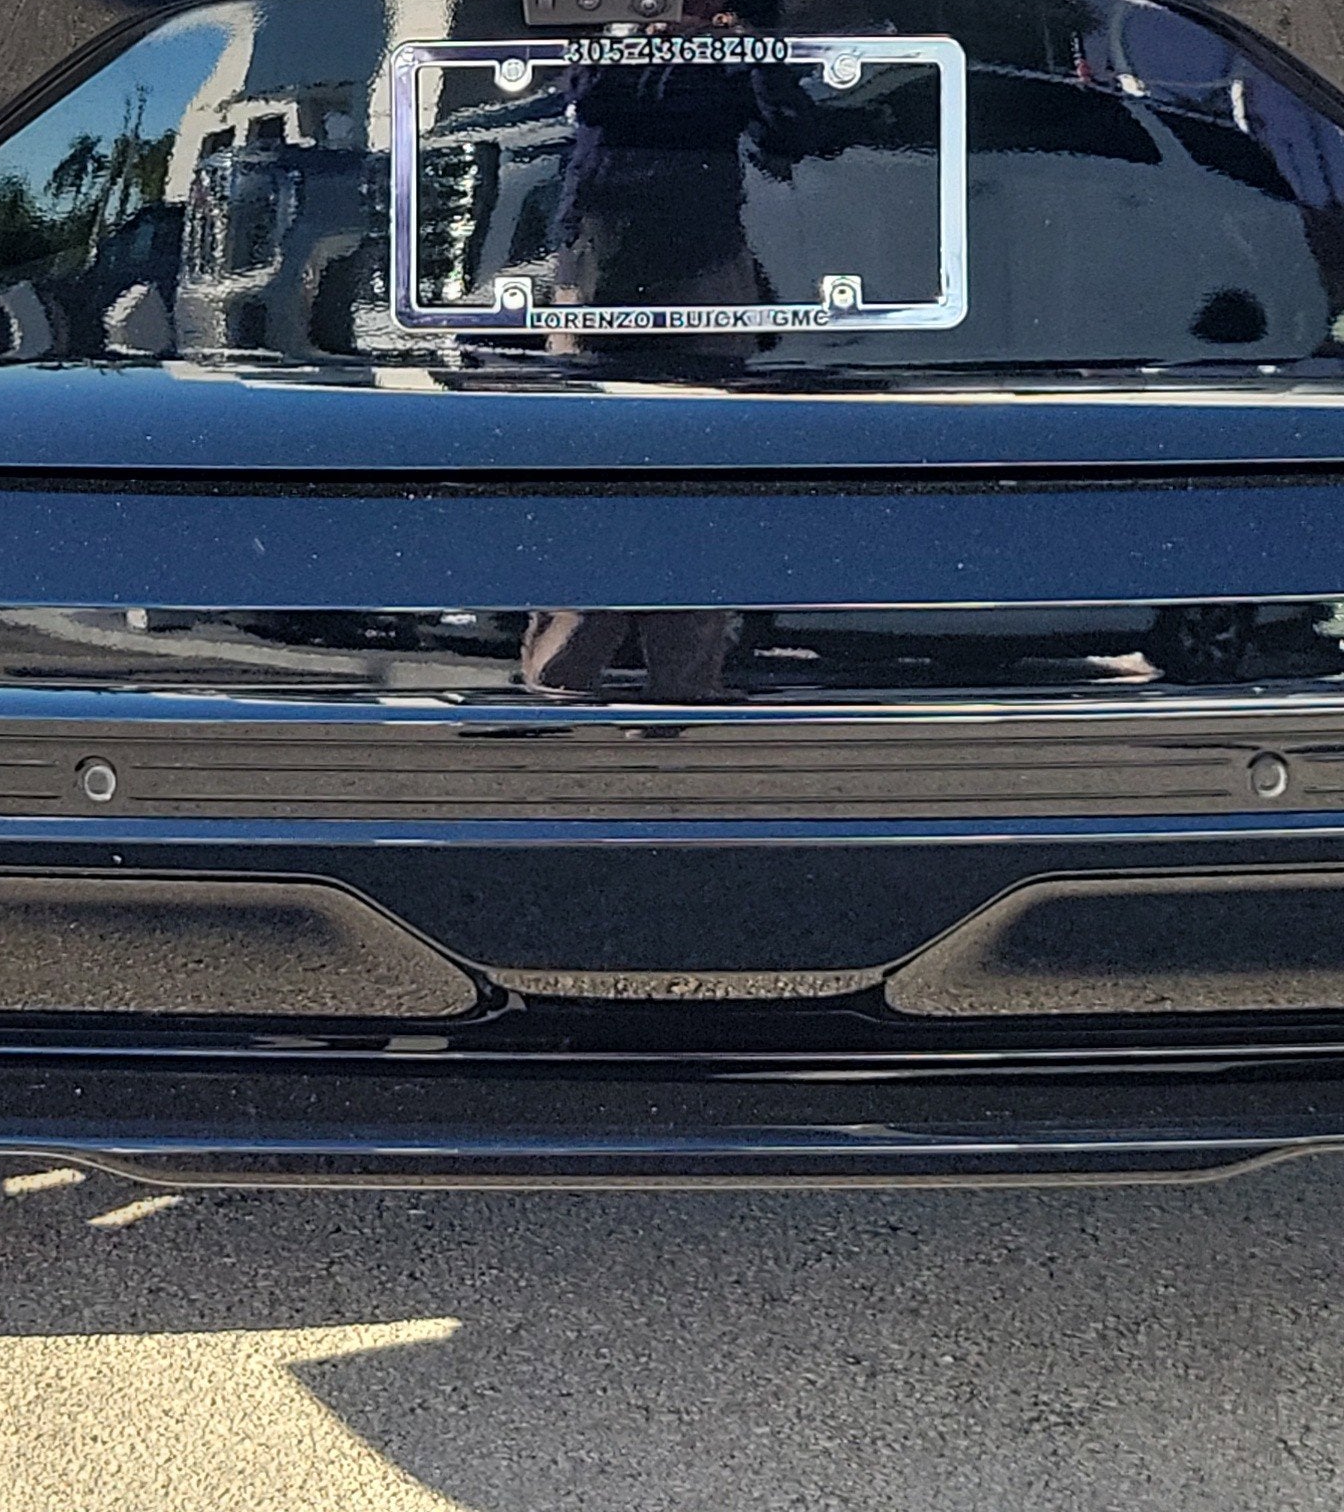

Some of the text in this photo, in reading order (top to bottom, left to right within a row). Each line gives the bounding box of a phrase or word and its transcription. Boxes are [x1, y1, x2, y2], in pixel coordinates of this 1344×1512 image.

[563, 36, 790, 64] 305-436-8400
[530, 309, 830, 329] LORENZO BUICK GMC
